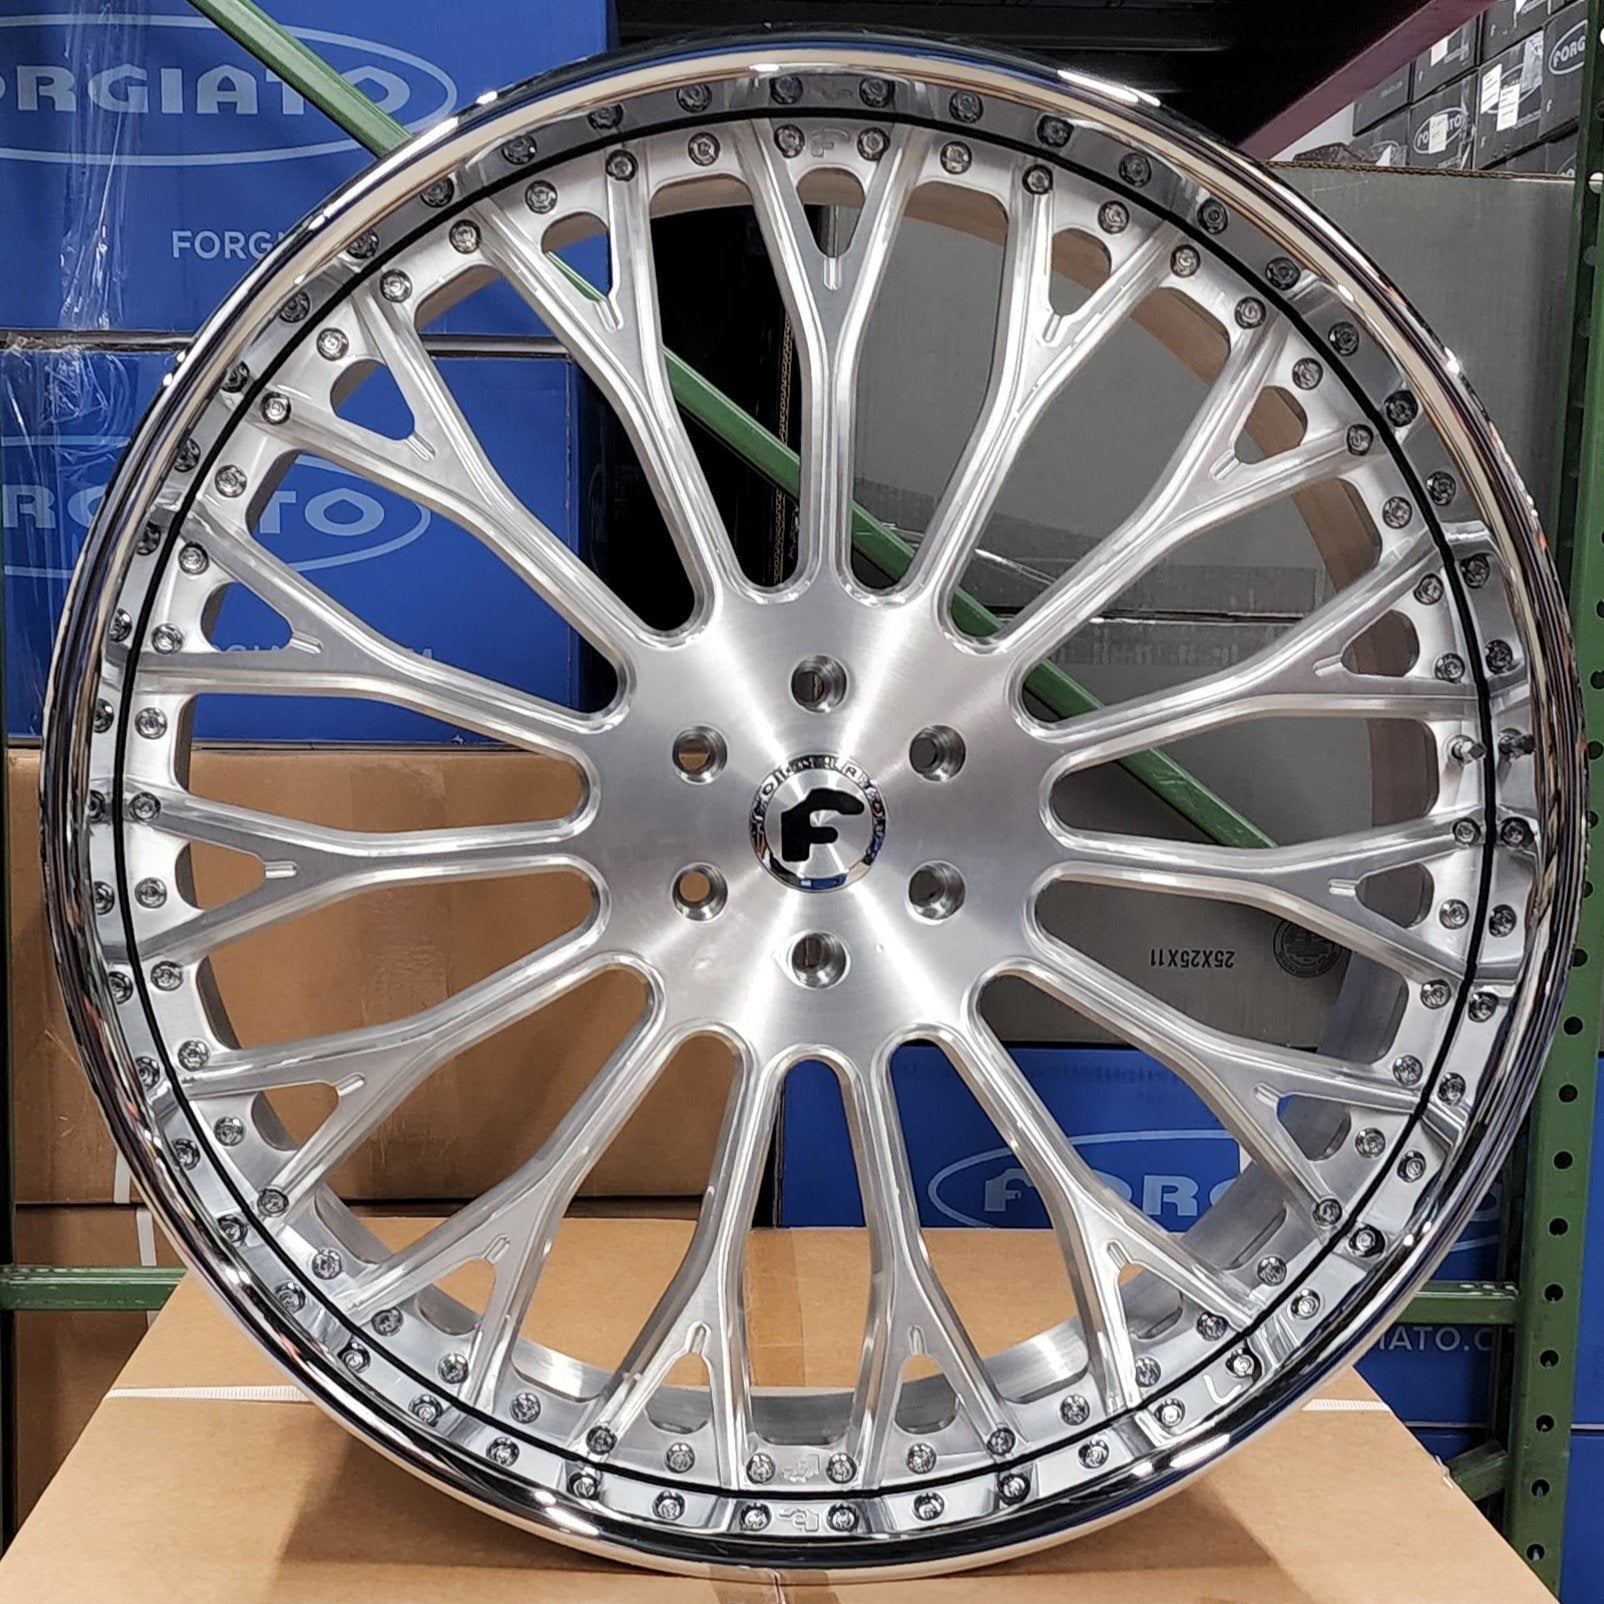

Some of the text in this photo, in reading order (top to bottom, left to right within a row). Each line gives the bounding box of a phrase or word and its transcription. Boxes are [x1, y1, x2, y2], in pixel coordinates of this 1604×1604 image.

[0, 63, 411, 115] RGIATO
[172, 230, 286, 259] FORG
[1150, 949, 1236, 970] 25X25X11
